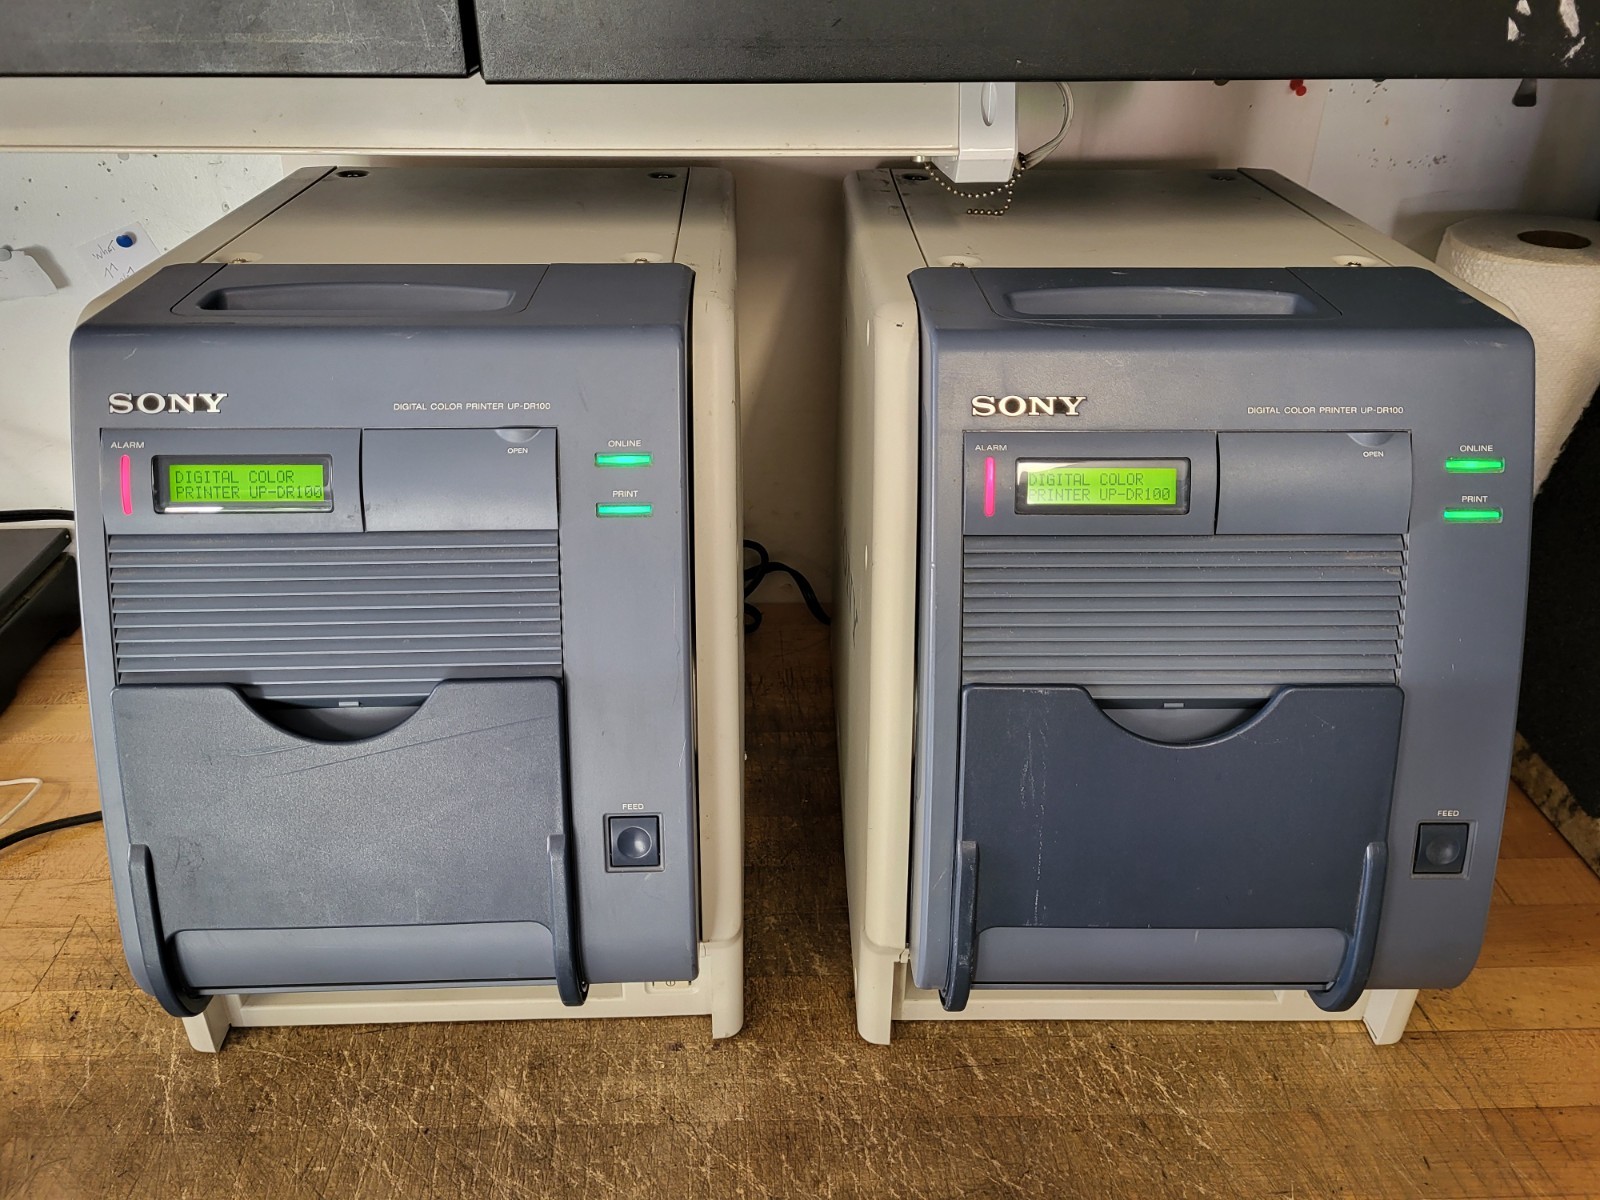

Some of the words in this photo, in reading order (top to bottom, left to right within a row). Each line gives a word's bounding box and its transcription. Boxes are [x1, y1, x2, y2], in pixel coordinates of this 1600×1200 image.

[108, 392, 228, 414] SONY
[393, 402, 428, 411] DIGITAL
[430, 402, 463, 411] COLOR
[465, 402, 504, 411] PRINTER
[507, 402, 551, 411] UP-DR100
[971, 395, 1088, 417] SONY
[1247, 406, 1281, 415] DIGITAL
[1283, 406, 1316, 415] COLOR
[1319, 406, 1358, 415] PRINTER
[1360, 406, 1404, 415] UP-DR100
[110, 440, 145, 449] ALARM
[607, 439, 642, 448] ONLINE
[974, 443, 1008, 452] ALARM
[507, 447, 529, 455] OPEN
[1459, 444, 1494, 453] ONLINE
[1362, 450, 1385, 458] OPEN
[174, 470, 240, 484] DIGITAL
[248, 470, 295, 484] COLOR
[1028, 472, 1091, 486] DIGITAL
[1099, 472, 1145, 486] COLOR
[175, 485, 241, 499] PRINTER
[249, 485, 323, 499] UP-DR100
[612, 490, 639, 498] PRINT
[1028, 488, 1091, 501] PRINTER
[1099, 487, 1171, 501] UP-DR100
[1461, 495, 1489, 503] PRINT
[1437, 809, 1460, 817] FEED
